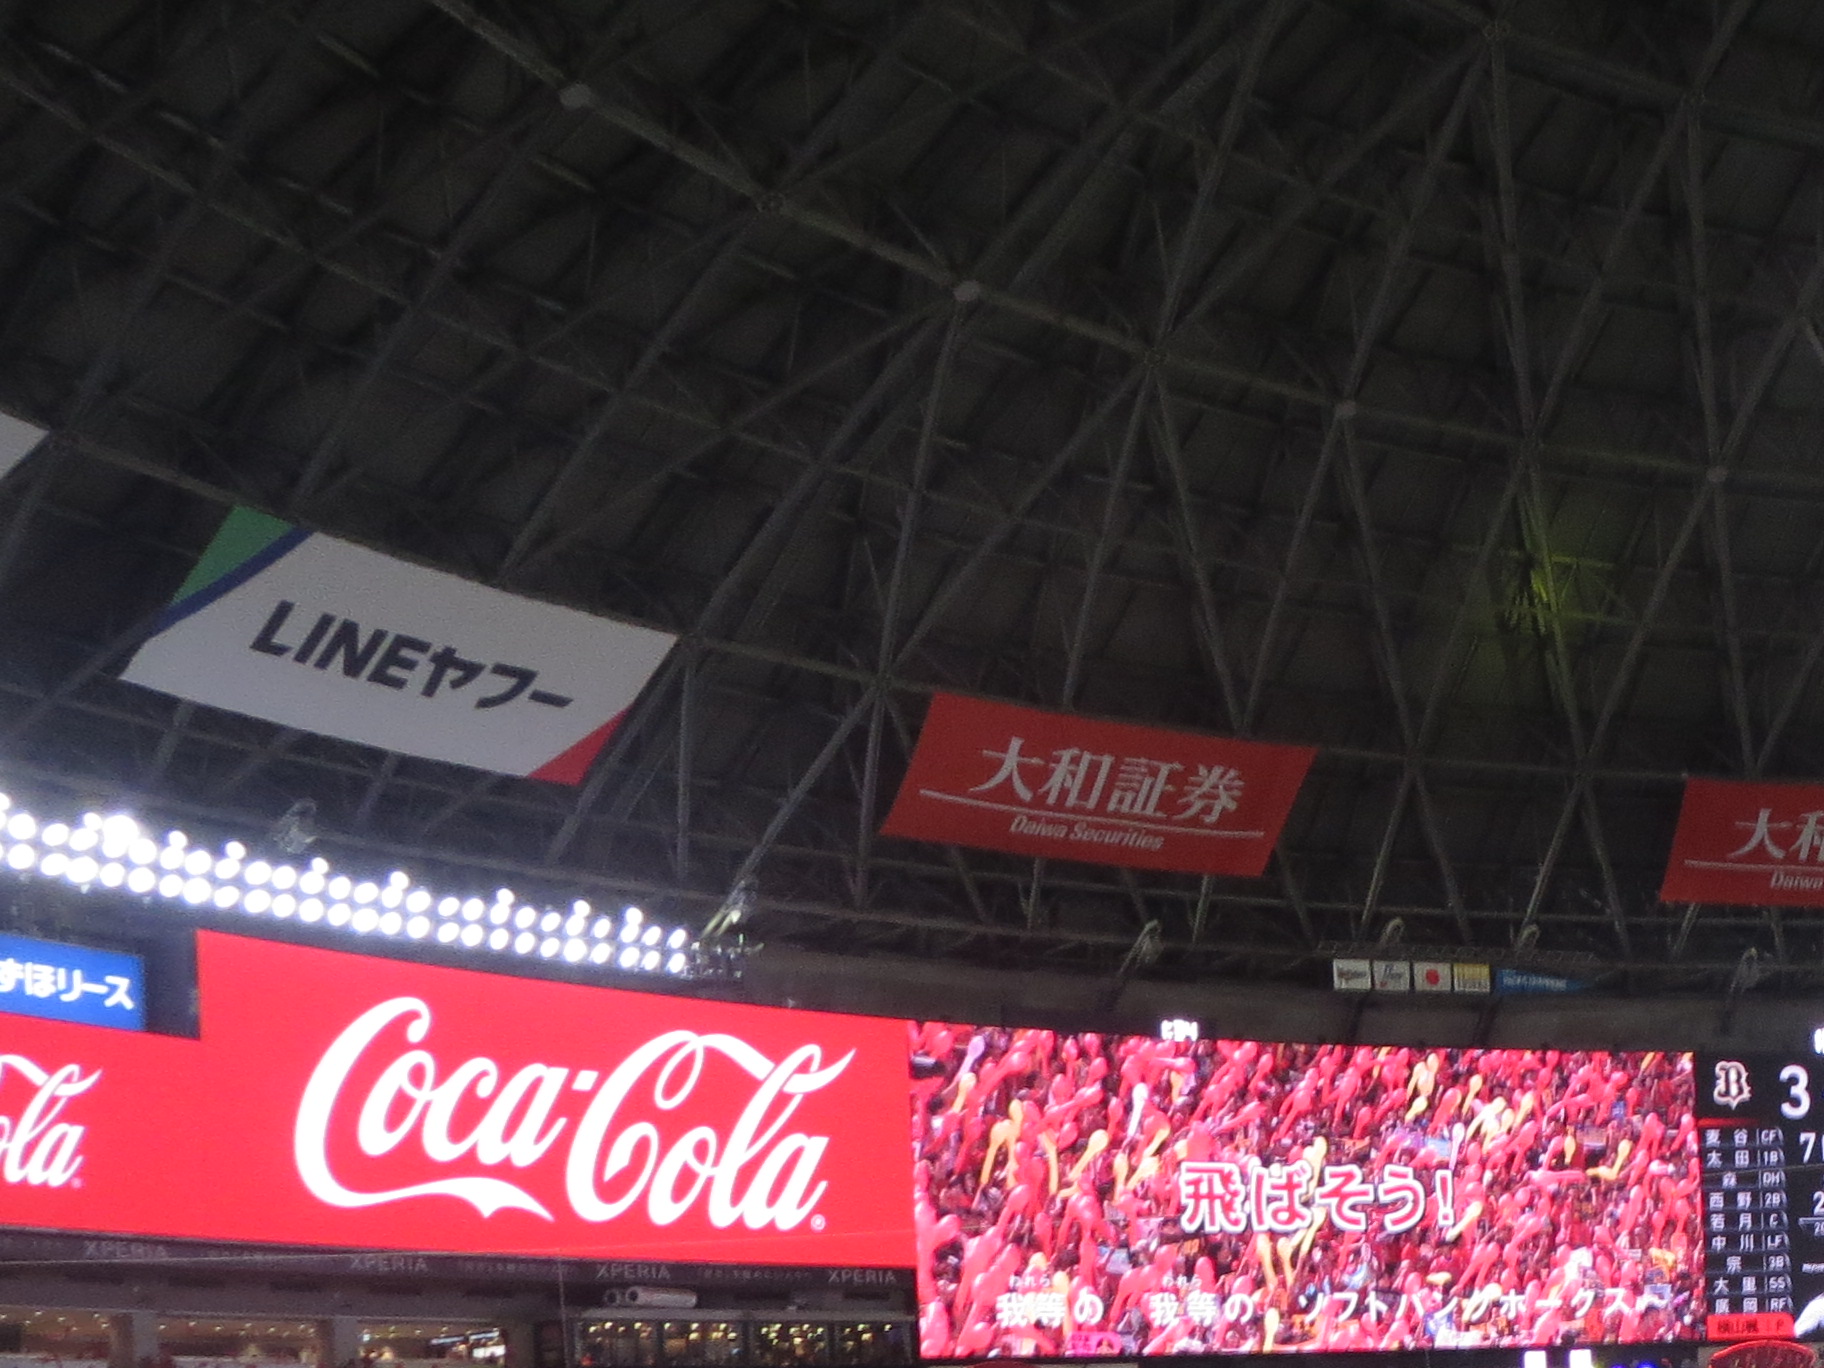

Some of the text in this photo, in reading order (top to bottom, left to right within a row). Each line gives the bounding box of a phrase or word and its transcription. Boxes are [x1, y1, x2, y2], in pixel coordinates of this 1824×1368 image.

[250, 601, 573, 710] LINEヤフー
[969, 736, 1245, 823] 大和証券
[1010, 814, 1165, 851] Daiwa Securities
[1770, 871, 1824, 891] Daiwa
[1780, 1064, 1811, 1120] 3
[294, 996, 857, 1231] Coca-Cola
[1707, 1150, 1778, 1168] 太田 1B
[1763, 1172, 1780, 1187] DH
[1764, 1192, 1780, 1208] 2B
[1711, 1234, 1754, 1253] 中川
[597, 1263, 671, 1280] XPERIA
[828, 1269, 897, 1285] XPERIA
[996, 1292, 1104, 1328] 我等の
[1149, 1291, 1254, 1327] 我等の
